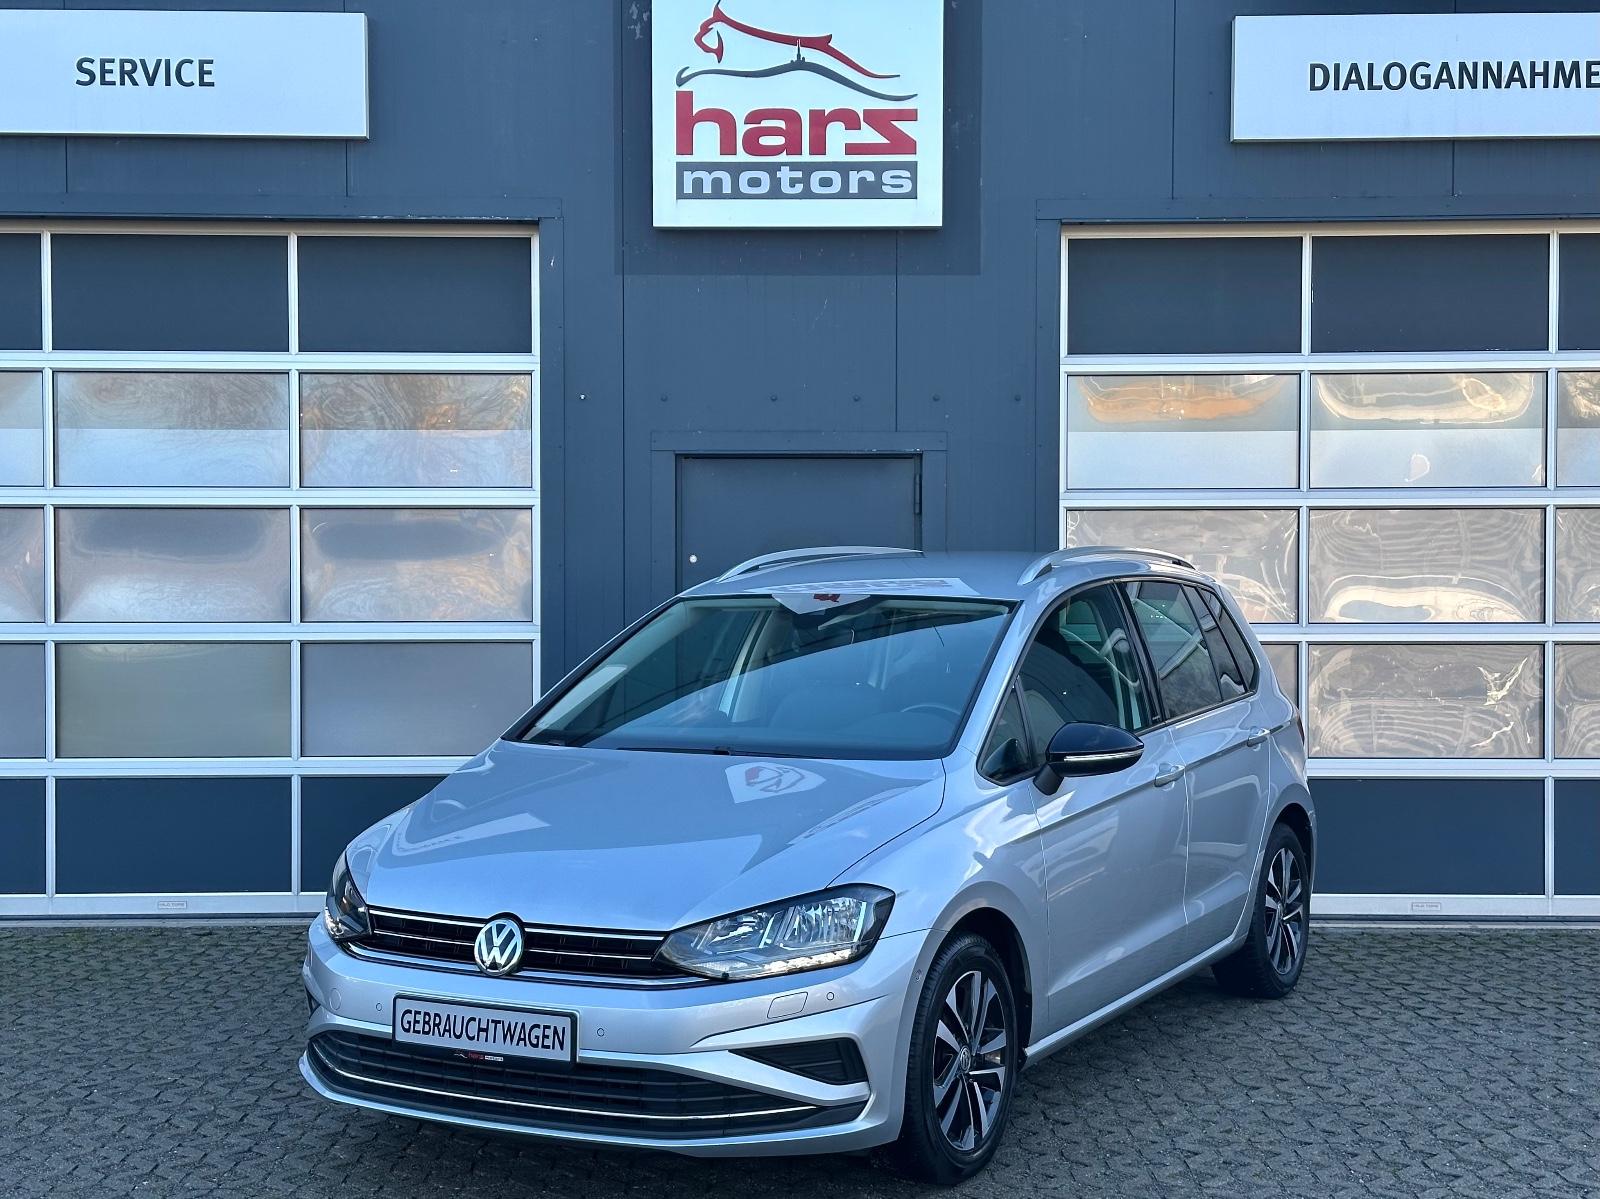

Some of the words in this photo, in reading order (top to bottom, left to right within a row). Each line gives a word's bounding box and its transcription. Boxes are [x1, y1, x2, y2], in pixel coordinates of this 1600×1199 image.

[76, 58, 214, 87] SERVICE
[1309, 61, 1600, 92] DIALOGANNAHME
[683, 166, 912, 194] motors
[475, 920, 521, 974] VW
[400, 1009, 566, 1051] GEBRAUCHTWAGEN
